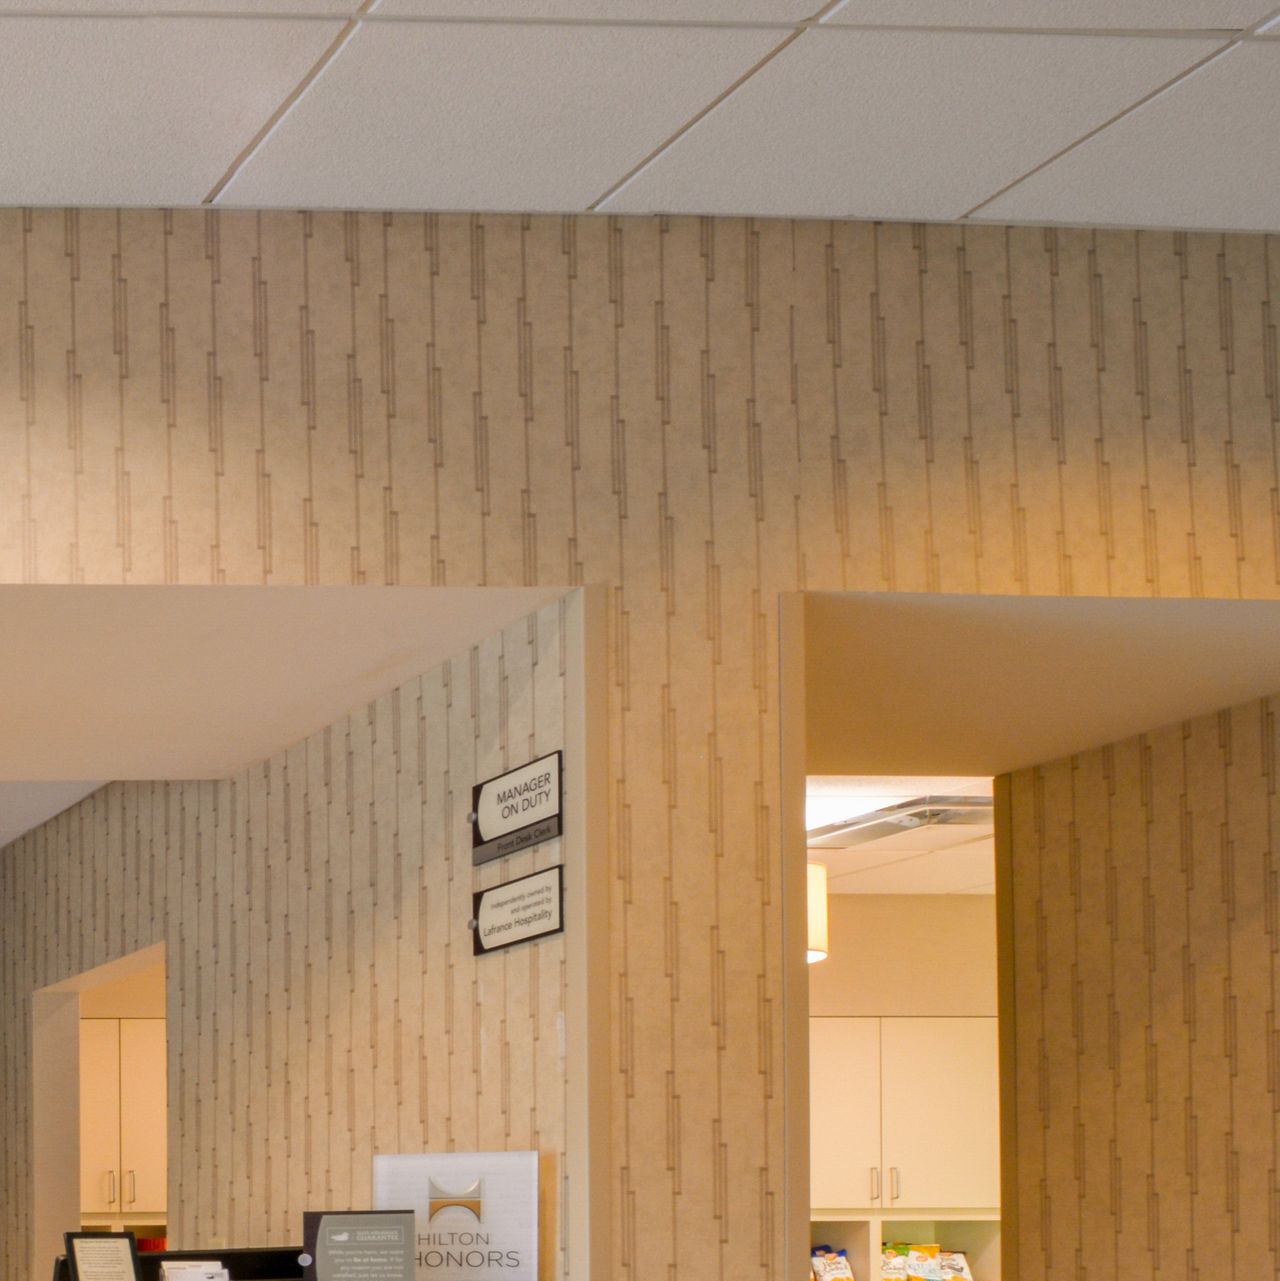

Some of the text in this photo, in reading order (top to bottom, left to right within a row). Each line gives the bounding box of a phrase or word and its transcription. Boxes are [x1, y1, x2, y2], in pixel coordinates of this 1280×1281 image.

[497, 773, 551, 805] MANAGER
[501, 788, 551, 819] ON DUTY
[483, 909, 552, 937] Lafrance Hospitality
[417, 1232, 489, 1246] HILTON
